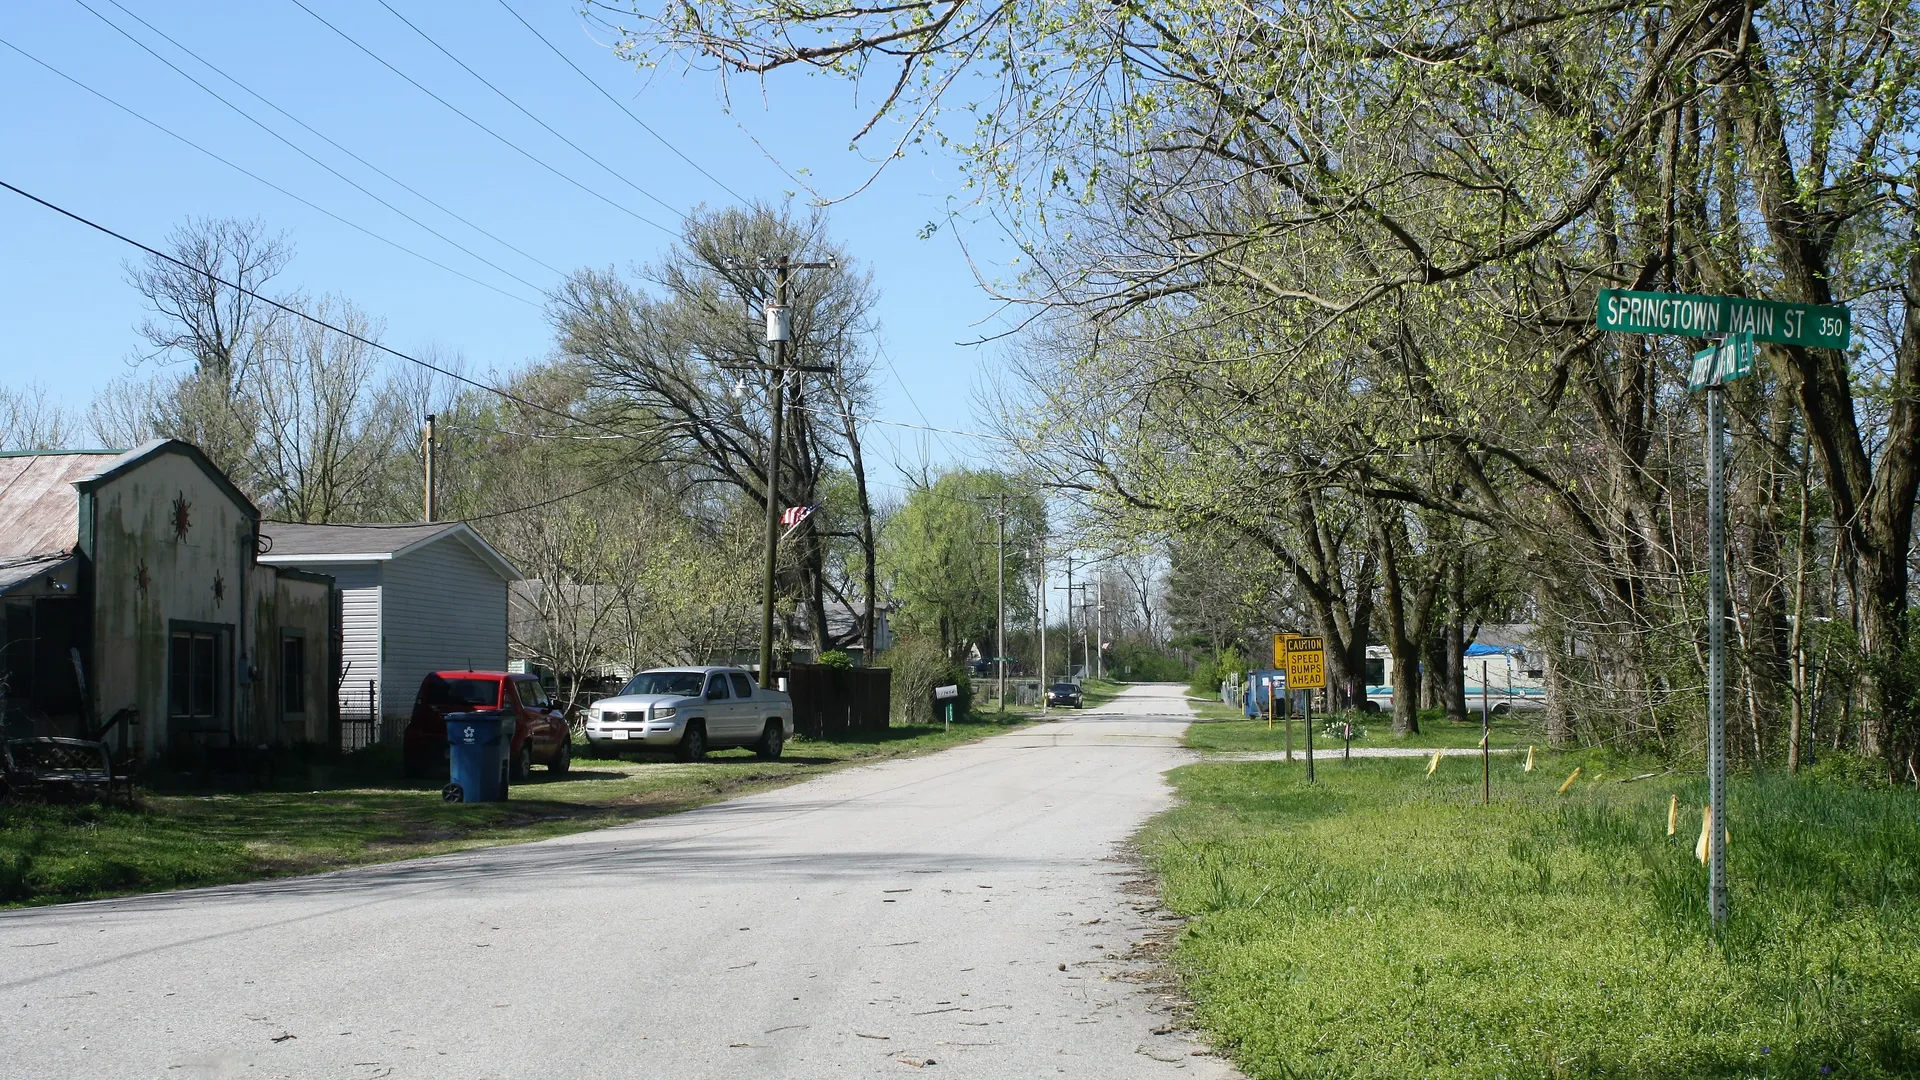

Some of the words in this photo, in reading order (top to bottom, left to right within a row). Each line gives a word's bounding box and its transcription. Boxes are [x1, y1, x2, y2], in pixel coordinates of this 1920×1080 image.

[1607, 296, 1719, 331] SPRINGTOWN
[1729, 304, 1774, 336] MAIN
[1784, 309, 1805, 338] ST
[1819, 317, 1842, 337] 350
[1288, 640, 1322, 650] CAUTION
[1291, 654, 1320, 664] SPEED
[1291, 664, 1321, 674] BUMPS
[1292, 674, 1321, 684] AHEAD
